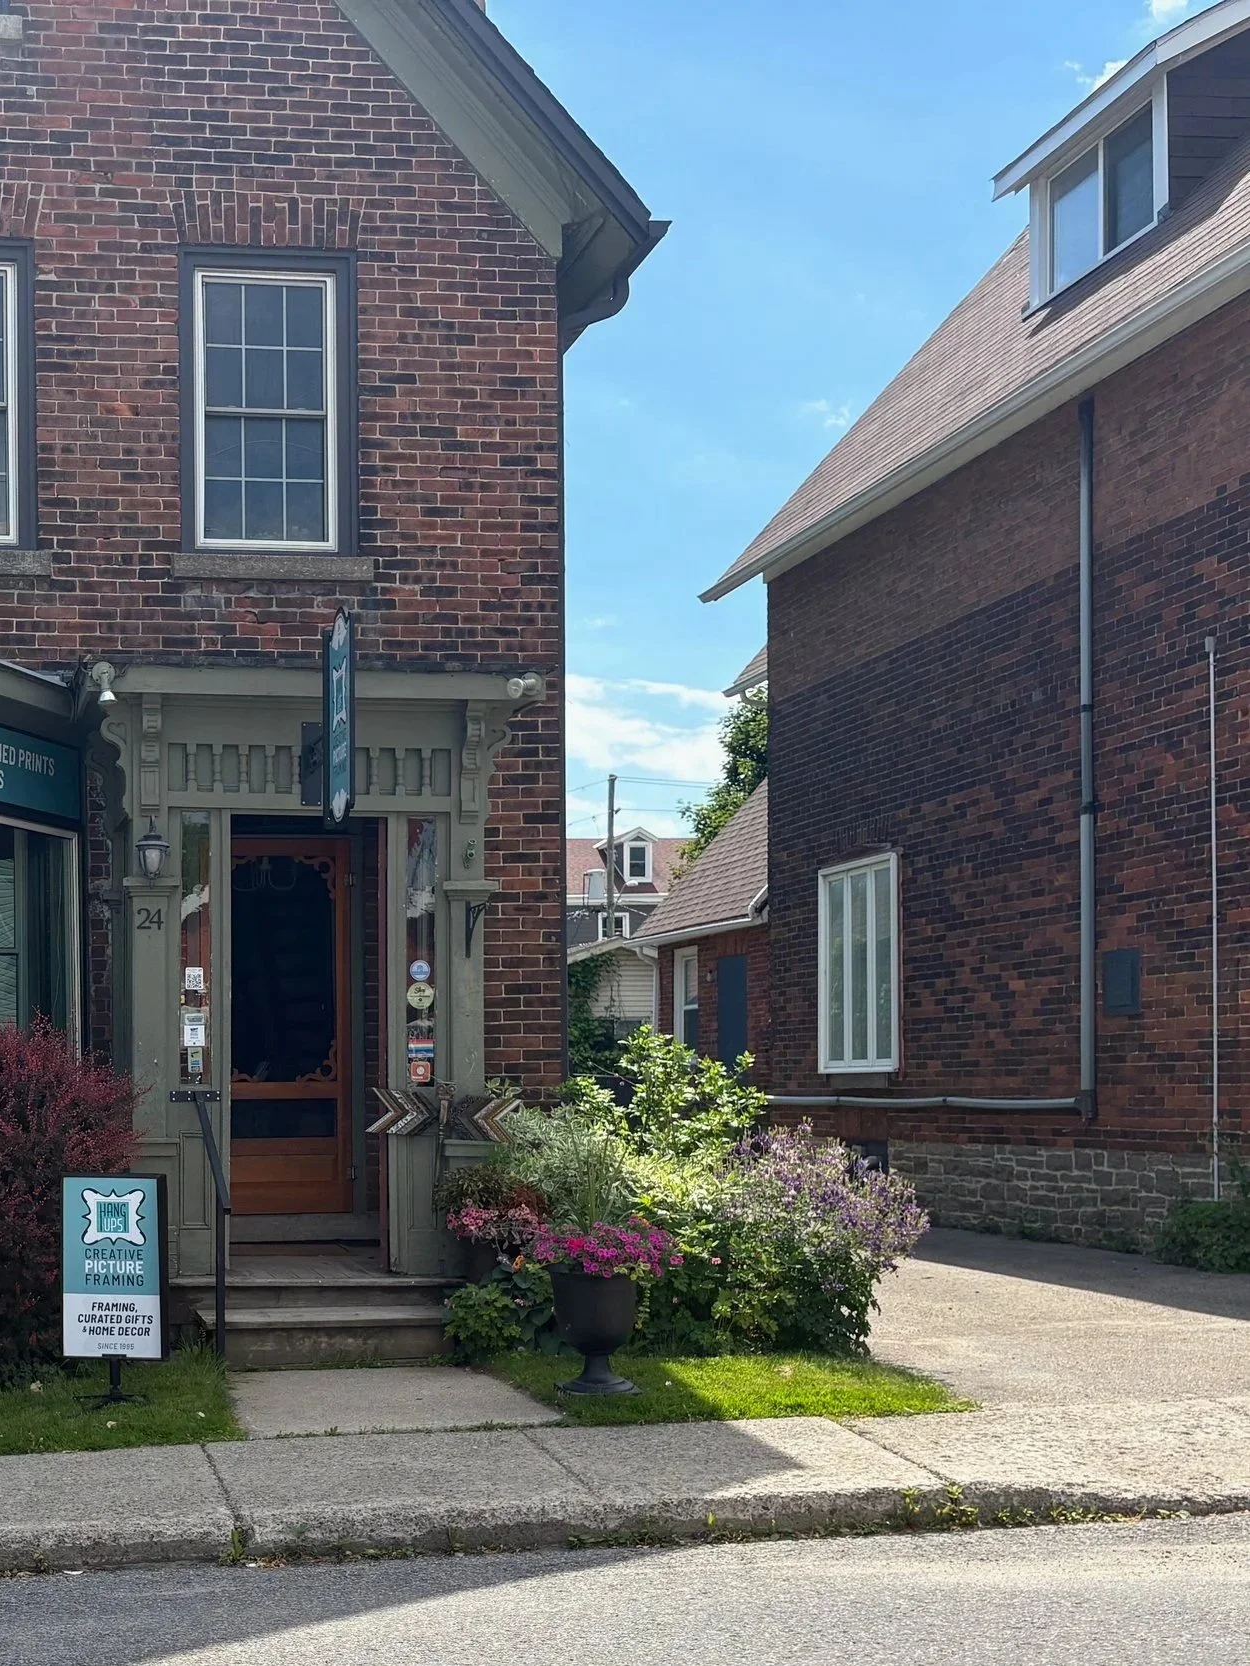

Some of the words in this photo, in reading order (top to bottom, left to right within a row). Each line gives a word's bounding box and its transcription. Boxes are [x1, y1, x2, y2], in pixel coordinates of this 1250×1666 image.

[18, 749, 55, 776] PRINTS
[137, 908, 164, 930] 24
[100, 1203, 127, 1231] HANG
[104, 1218, 123, 1231] UPS
[85, 1249, 144, 1260] CREATIVE
[85, 1260, 144, 1274] PICTURE
[85, 1274, 144, 1286] FRAMING
[91, 1302, 138, 1313] FRAMING,
[78, 1314, 122, 1324] CURATED
[125, 1315, 154, 1324] GIFTS
[88, 1326, 115, 1336] HOME
[118, 1327, 151, 1336] DECOR
